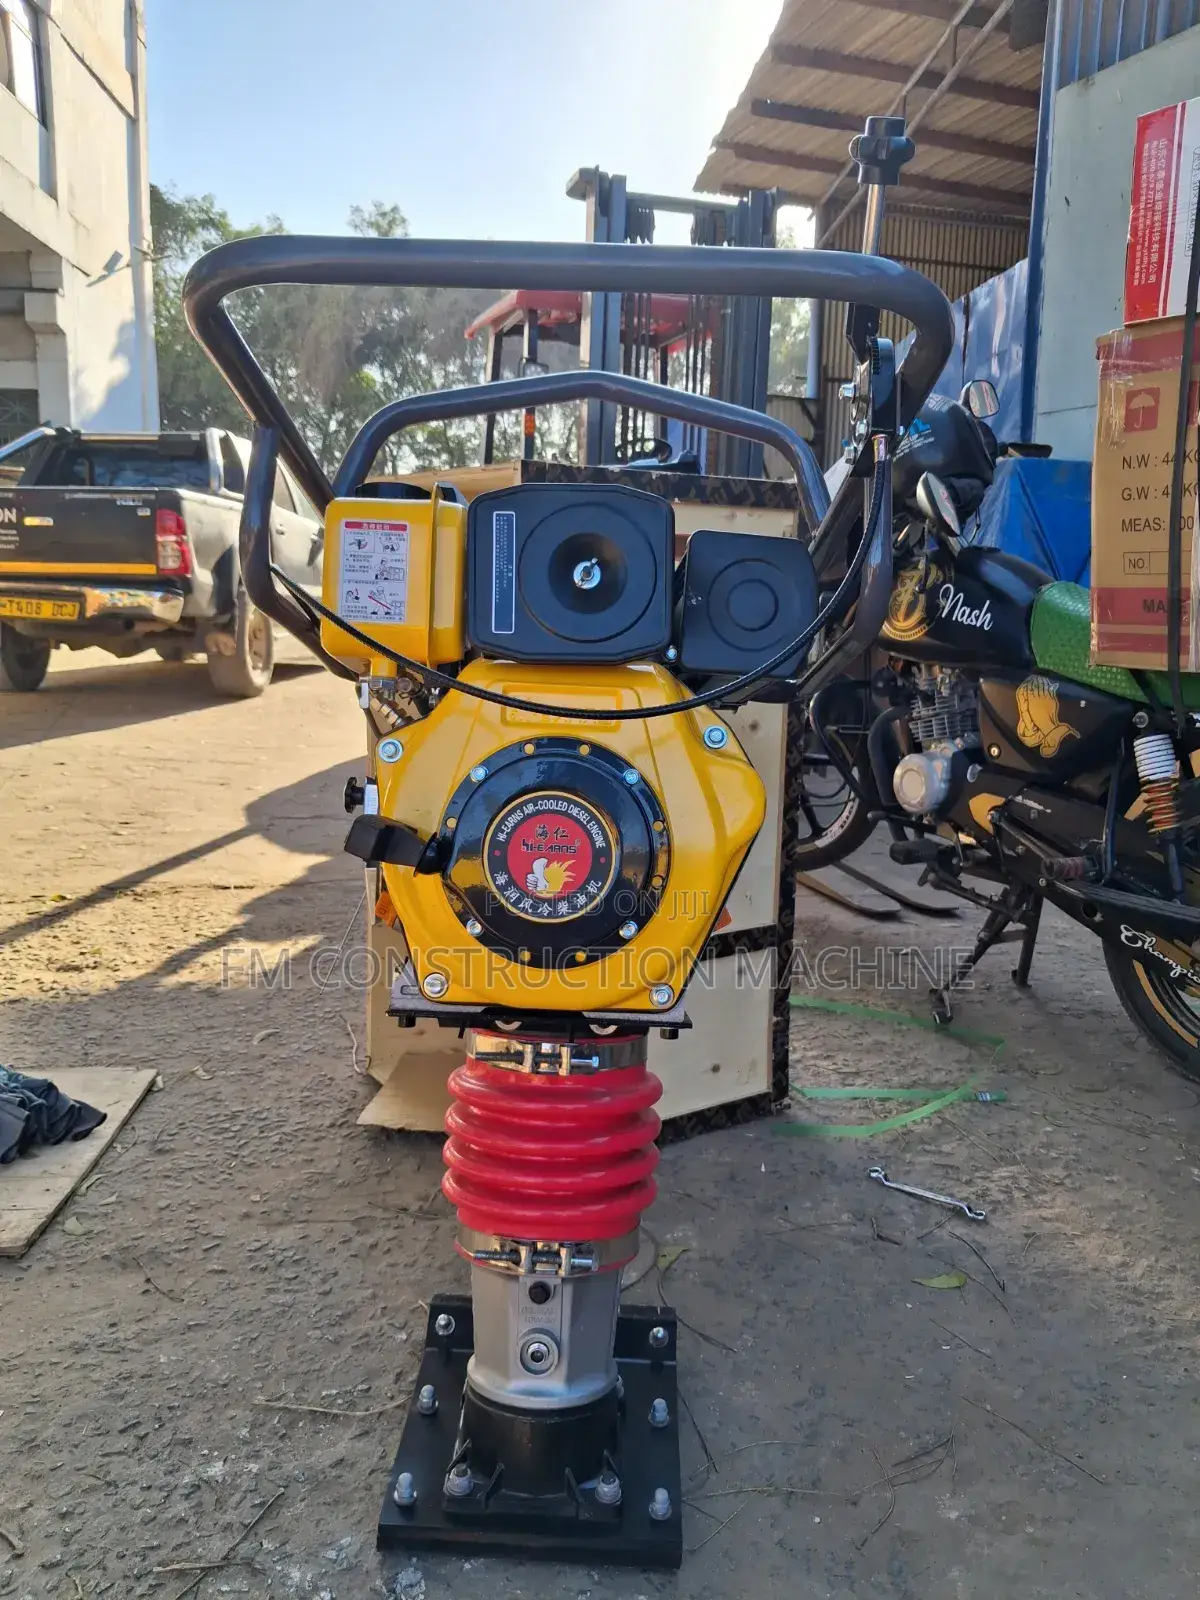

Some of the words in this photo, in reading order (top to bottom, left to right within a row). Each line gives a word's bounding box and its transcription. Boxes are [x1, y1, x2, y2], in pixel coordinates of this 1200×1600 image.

[1122, 453, 1151, 470] N.W
[1121, 486, 1150, 502] G.W
[0, 507, 17, 523] N
[1121, 517, 1166, 533] MEAS:
[1128, 557, 1149, 570] NO.
[939, 583, 994, 631] Nash
[496, 809, 524, 843] HI-EARNS
[522, 799, 568, 817] AIR-COOLED
[567, 804, 591, 826] DIESEL
[586, 820, 606, 849] ENGINE
[493, 870, 603, 917] 海润风冷柴油机
